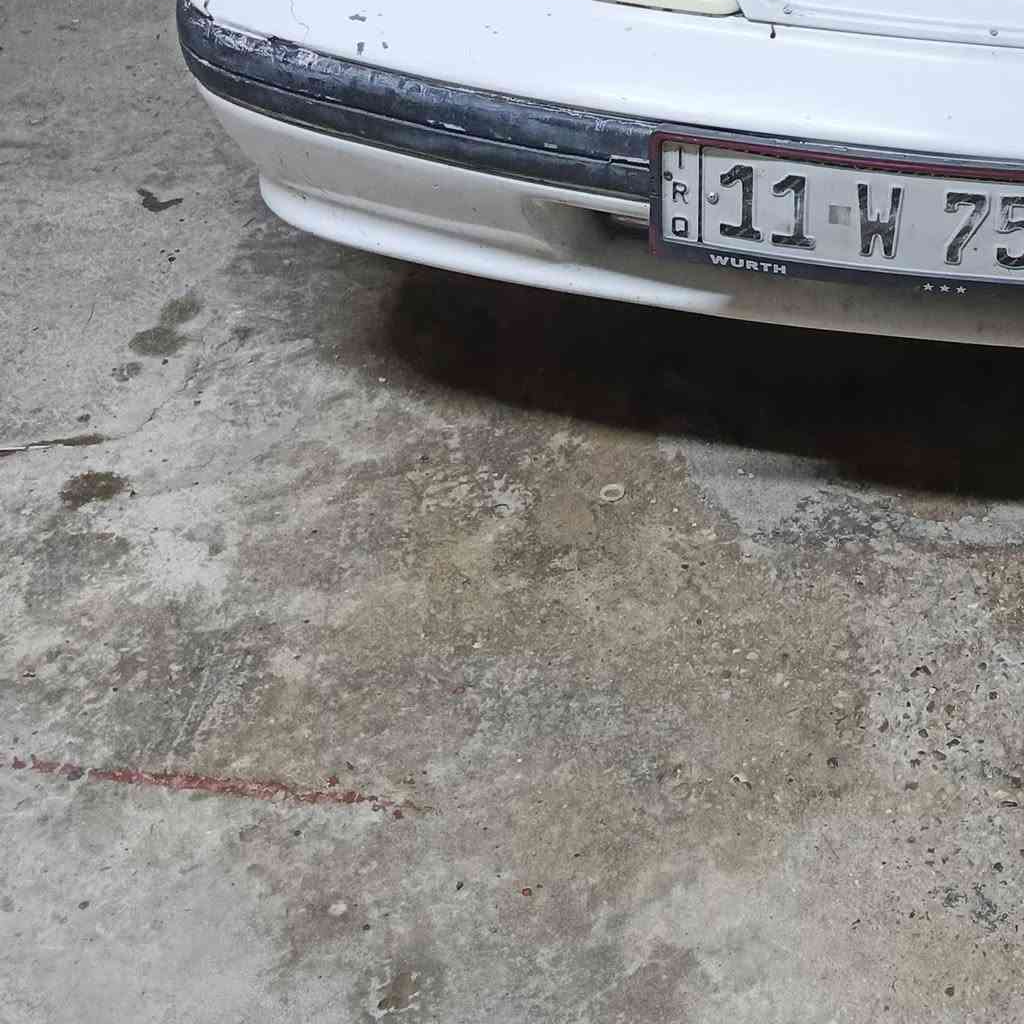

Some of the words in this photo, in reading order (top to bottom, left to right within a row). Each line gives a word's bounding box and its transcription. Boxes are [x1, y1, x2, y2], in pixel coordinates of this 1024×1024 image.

[719, 164, 815, 251] 11
[857, 182, 903, 259] W
[709, 253, 787, 275] WURTH
